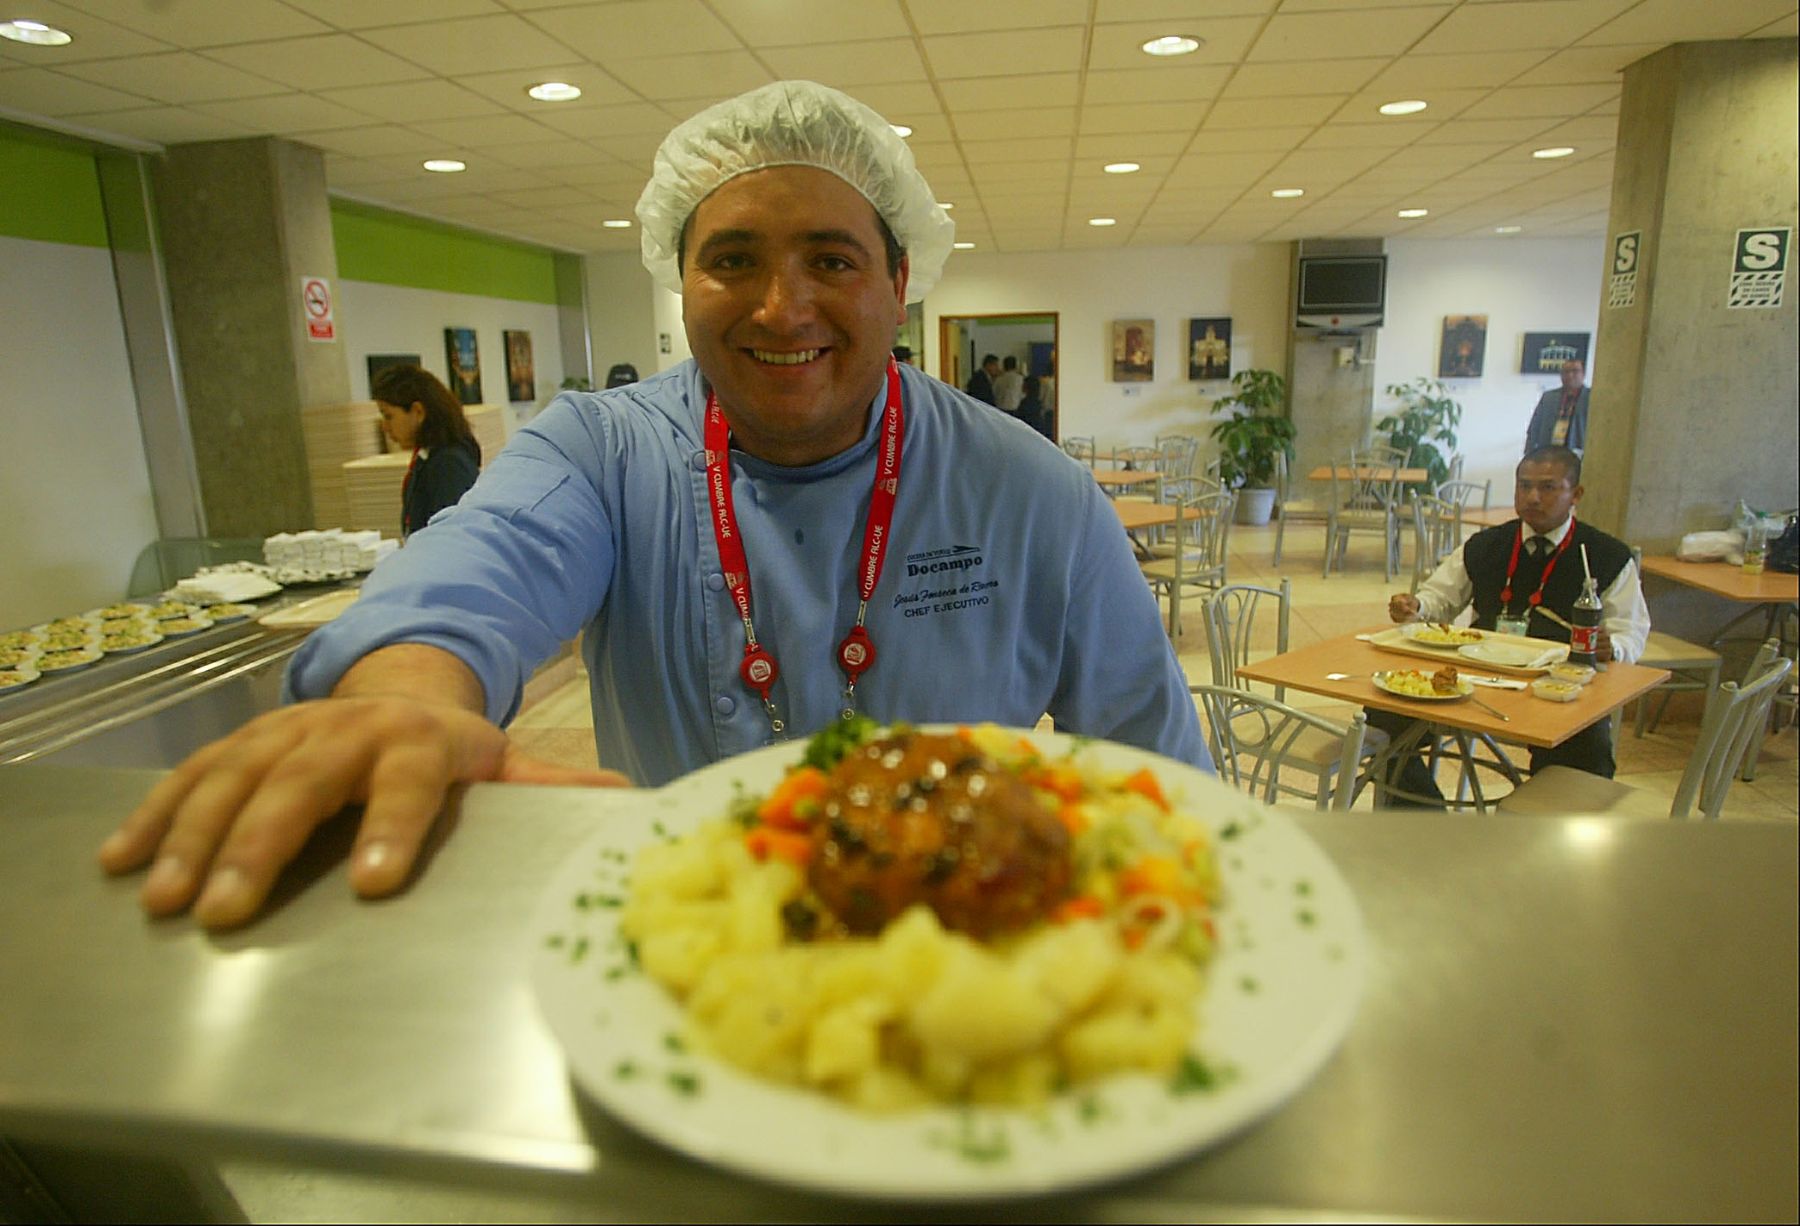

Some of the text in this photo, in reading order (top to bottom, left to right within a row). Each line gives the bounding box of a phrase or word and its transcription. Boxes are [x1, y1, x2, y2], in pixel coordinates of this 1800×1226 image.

[1616, 237, 1636, 272] S
[1742, 233, 1780, 269] S
[884, 405, 898, 475] V CUMBRE ALC-UE
[713, 465, 731, 538] V CUMBRE ALC-UE
[870, 524, 883, 555] ALC-UE
[864, 555, 879, 590] CUMBRE
[907, 556, 983, 577] Docampo
[736, 586, 744, 594] V
[904, 596, 989, 618] CHEF EJECUTIVO
